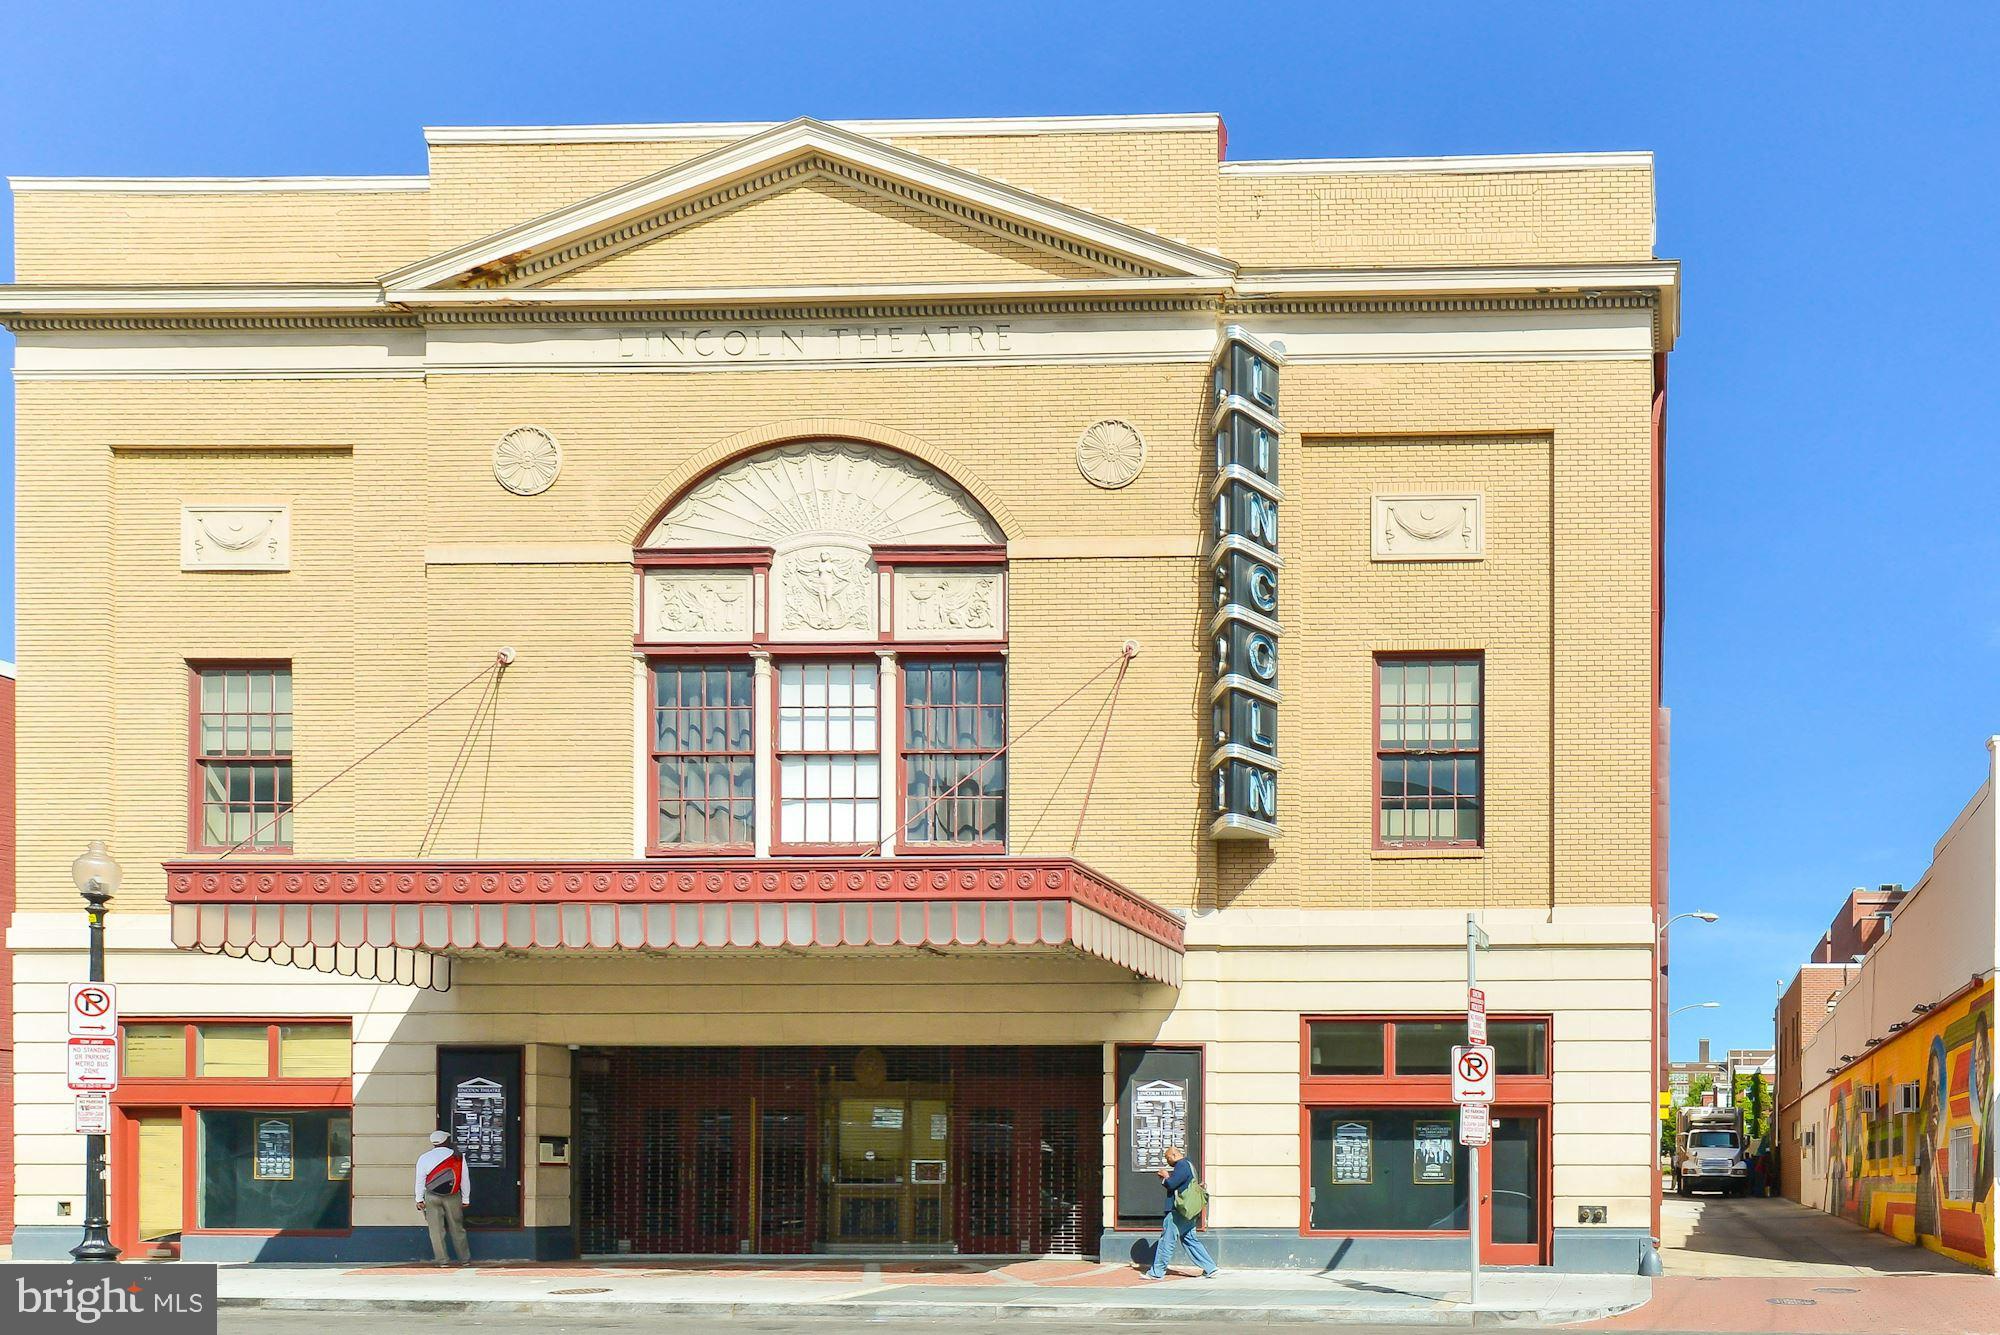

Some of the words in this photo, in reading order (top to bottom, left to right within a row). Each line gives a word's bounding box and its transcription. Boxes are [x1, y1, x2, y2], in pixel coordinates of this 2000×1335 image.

[617, 329, 804, 357] LINCOLN
[829, 324, 1012, 354] THEATRE
[1248, 354, 1278, 819] LINCOLN
